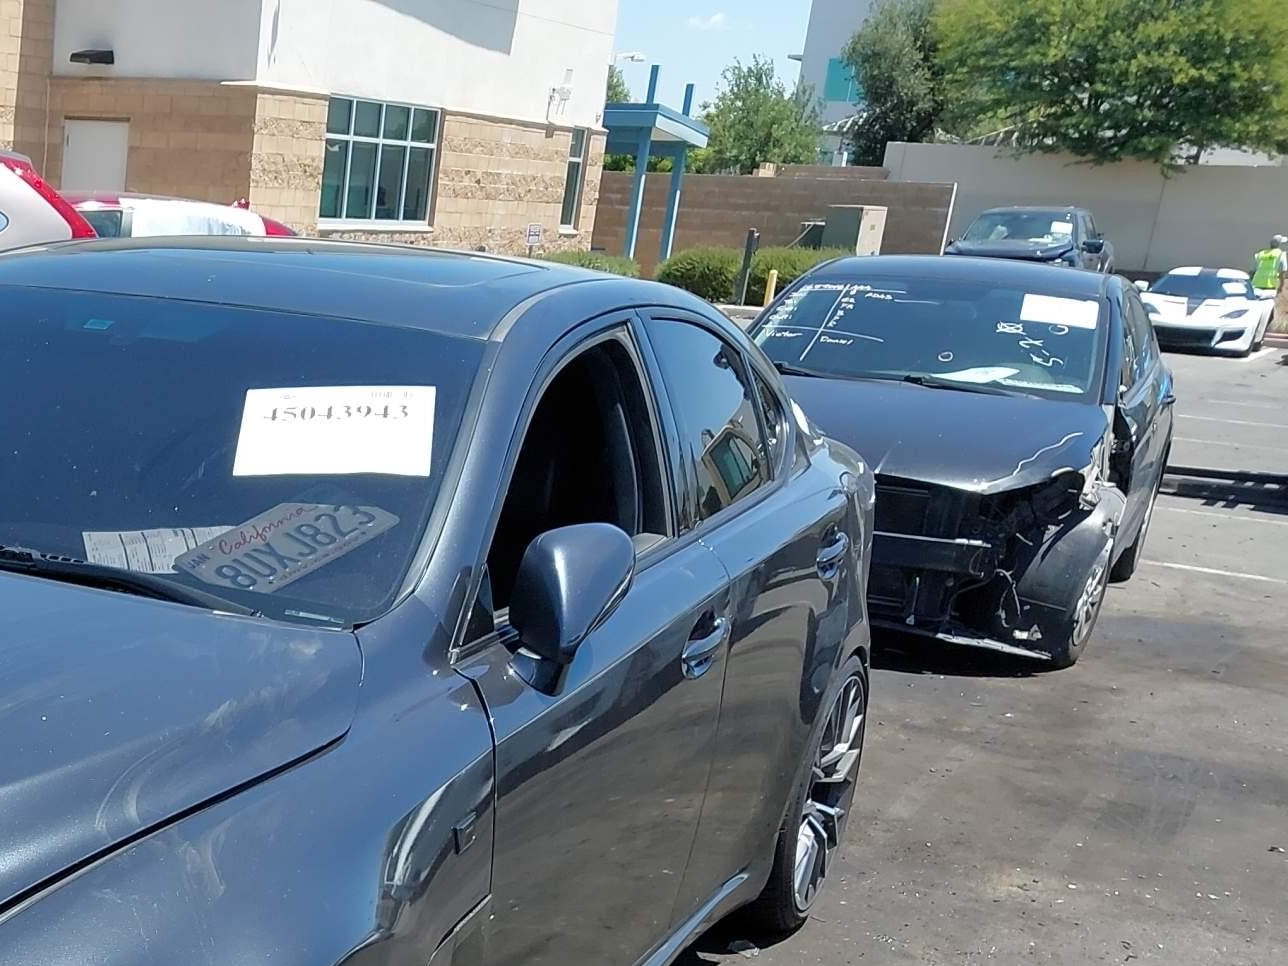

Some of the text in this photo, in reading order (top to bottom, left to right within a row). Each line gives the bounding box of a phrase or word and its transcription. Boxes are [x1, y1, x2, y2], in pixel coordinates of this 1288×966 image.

[263, 404, 409, 422] 45043943
[214, 504, 377, 589] 8UXJ823
[218, 506, 316, 556] California
